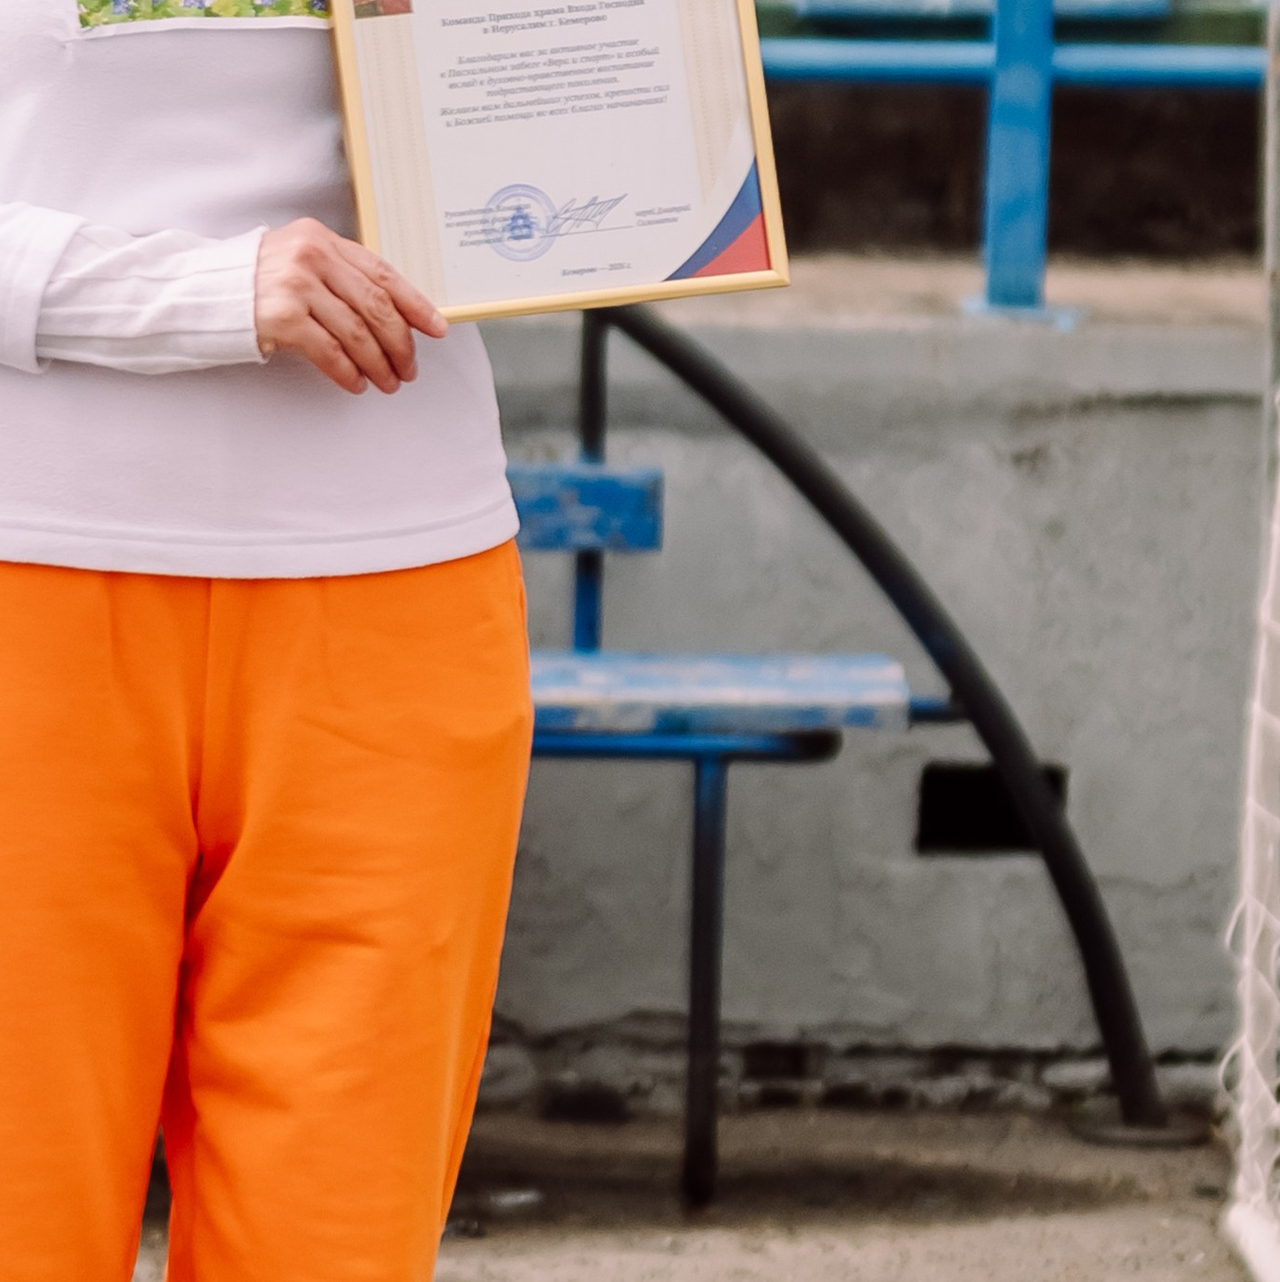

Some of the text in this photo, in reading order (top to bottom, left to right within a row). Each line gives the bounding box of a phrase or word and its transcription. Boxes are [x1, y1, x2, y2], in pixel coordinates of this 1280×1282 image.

[442, 15, 485, 26] Команда
[488, 9, 531, 23] Прихода
[534, 7, 564, 18] храма
[567, 3, 596, 13] Входа
[491, 20, 546, 34] Иерусалим
[559, 14, 607, 27] Кемерово
